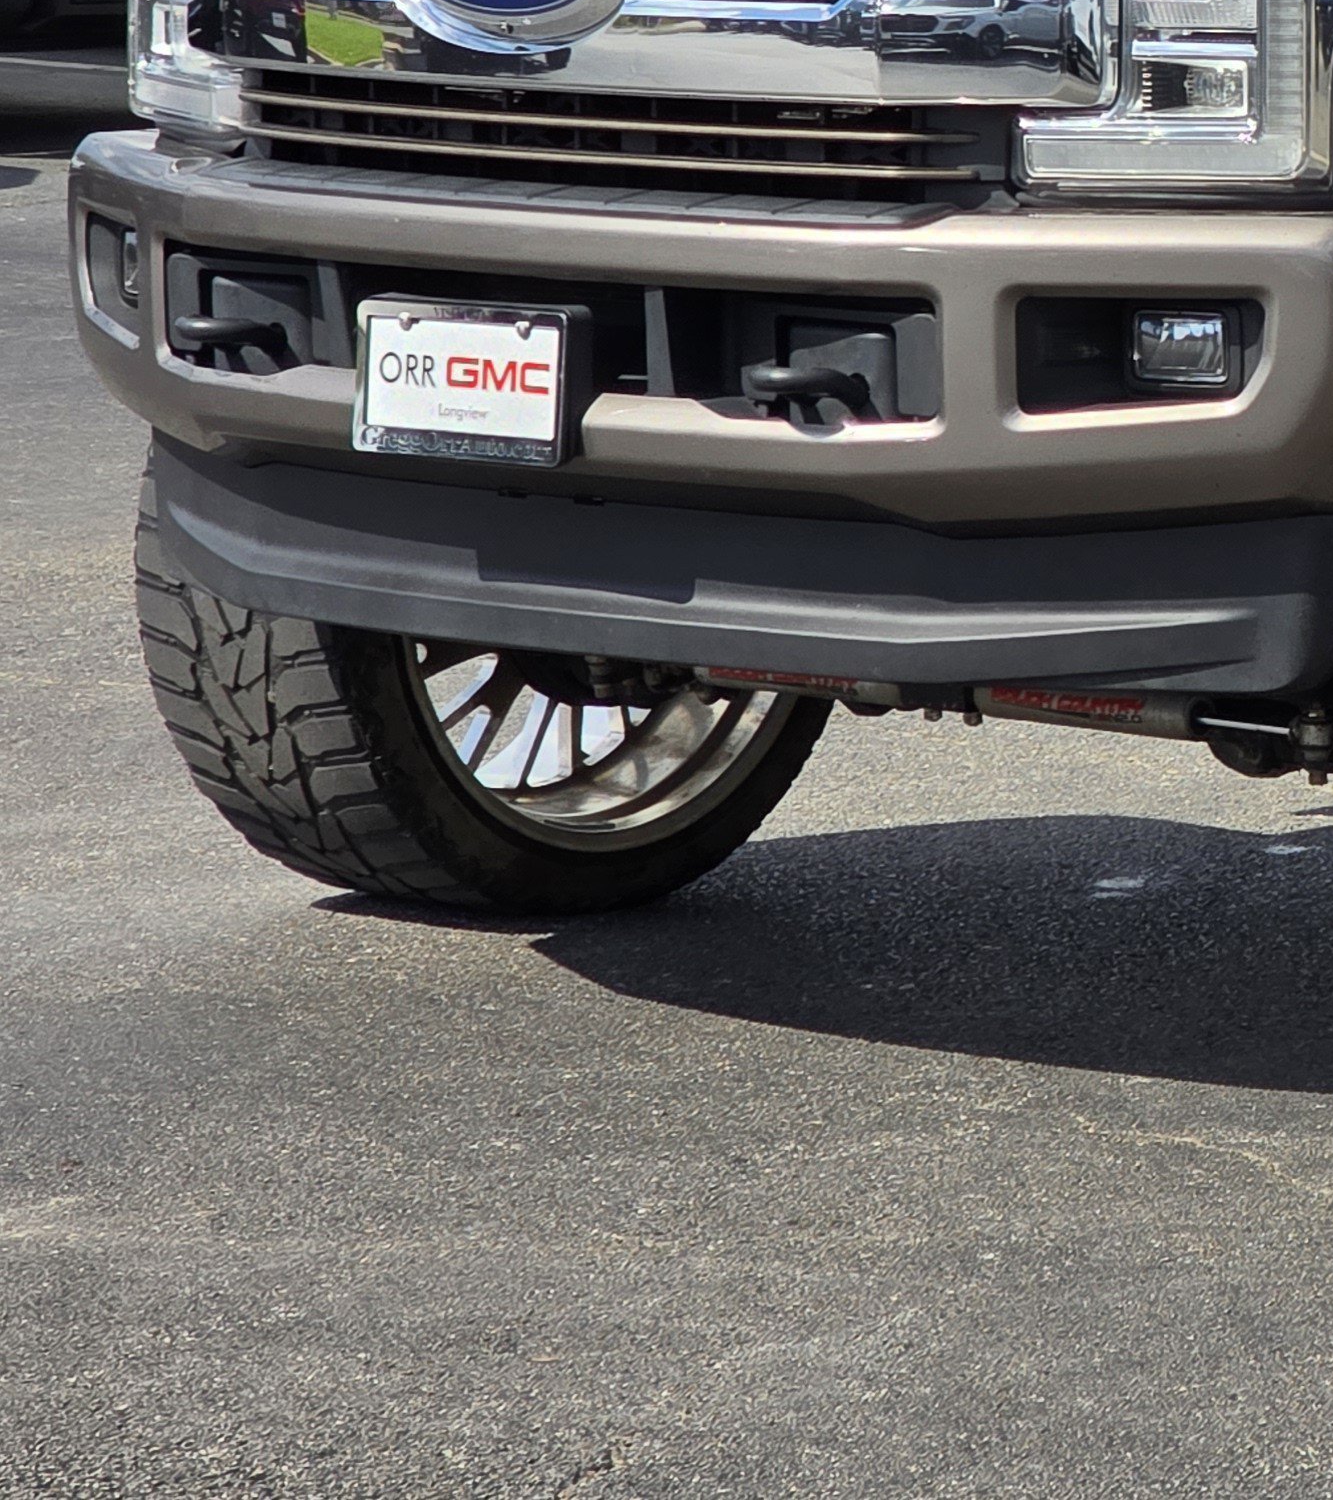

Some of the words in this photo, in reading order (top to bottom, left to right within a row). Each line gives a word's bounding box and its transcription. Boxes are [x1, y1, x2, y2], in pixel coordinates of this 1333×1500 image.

[379, 351, 436, 388] ORR
[446, 356, 551, 396] GMC
[438, 402, 490, 421] Longview
